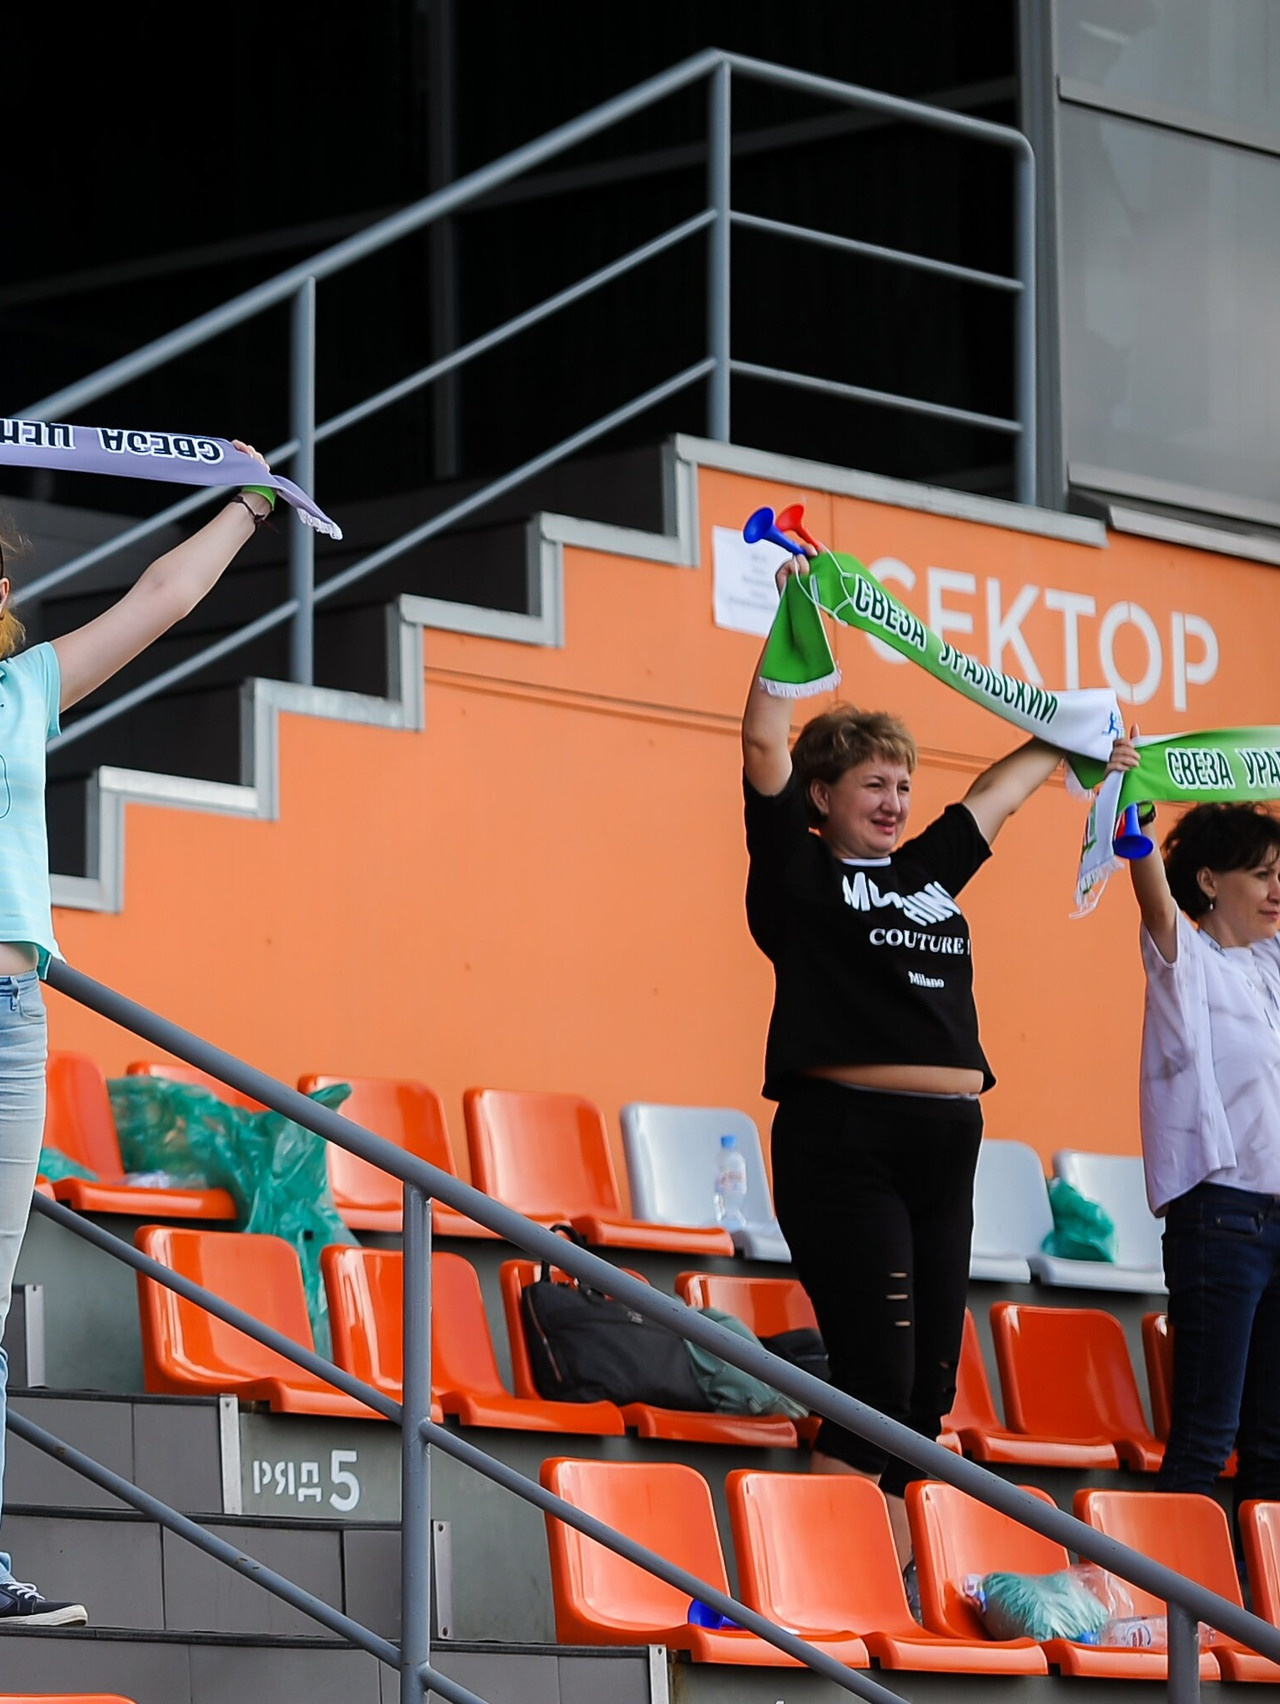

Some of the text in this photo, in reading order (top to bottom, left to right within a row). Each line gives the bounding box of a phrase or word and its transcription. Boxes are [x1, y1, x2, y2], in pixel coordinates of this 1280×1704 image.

[101, 428, 222, 462] СВЕЗА
[855, 576, 926, 649] СВЕЗА
[1166, 750, 1280, 787] СВЕЗА УРА
[328, 1449, 361, 1513] 5
